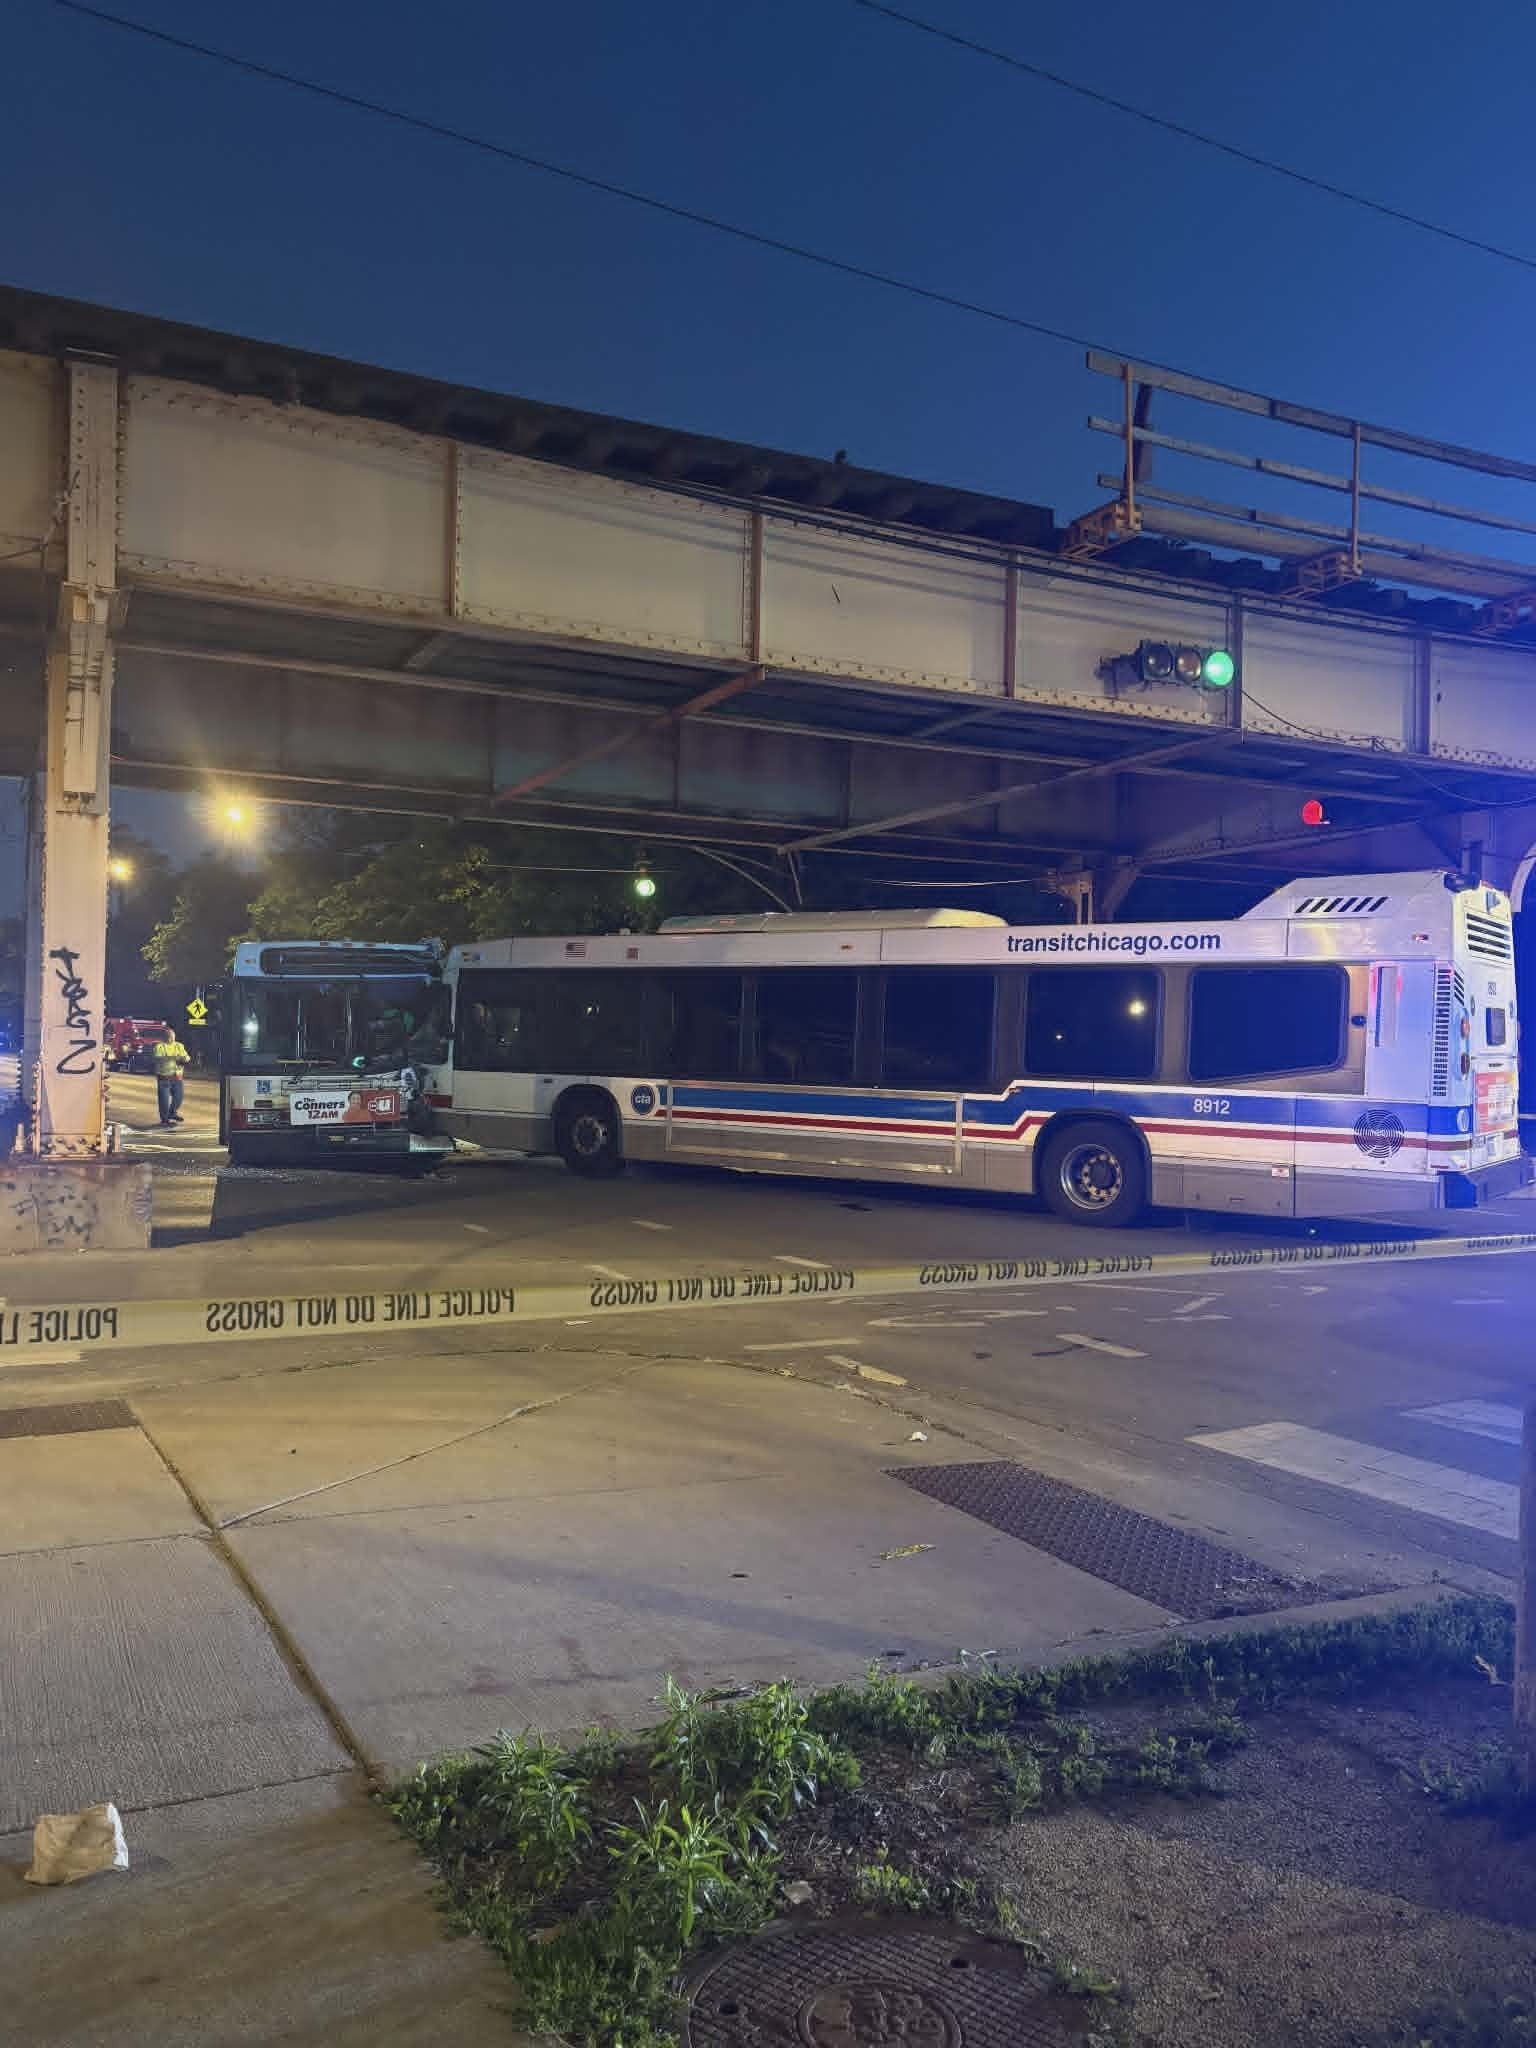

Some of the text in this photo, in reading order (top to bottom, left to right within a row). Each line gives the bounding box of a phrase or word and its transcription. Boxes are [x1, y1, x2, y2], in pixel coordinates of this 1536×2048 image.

[1007, 932, 1221, 955] transitchicago.com
[294, 1100, 345, 1110] Conners
[634, 1095, 651, 1105] cta
[1193, 1098, 1231, 1115] 8912
[308, 1110, 339, 1120] 12AM
